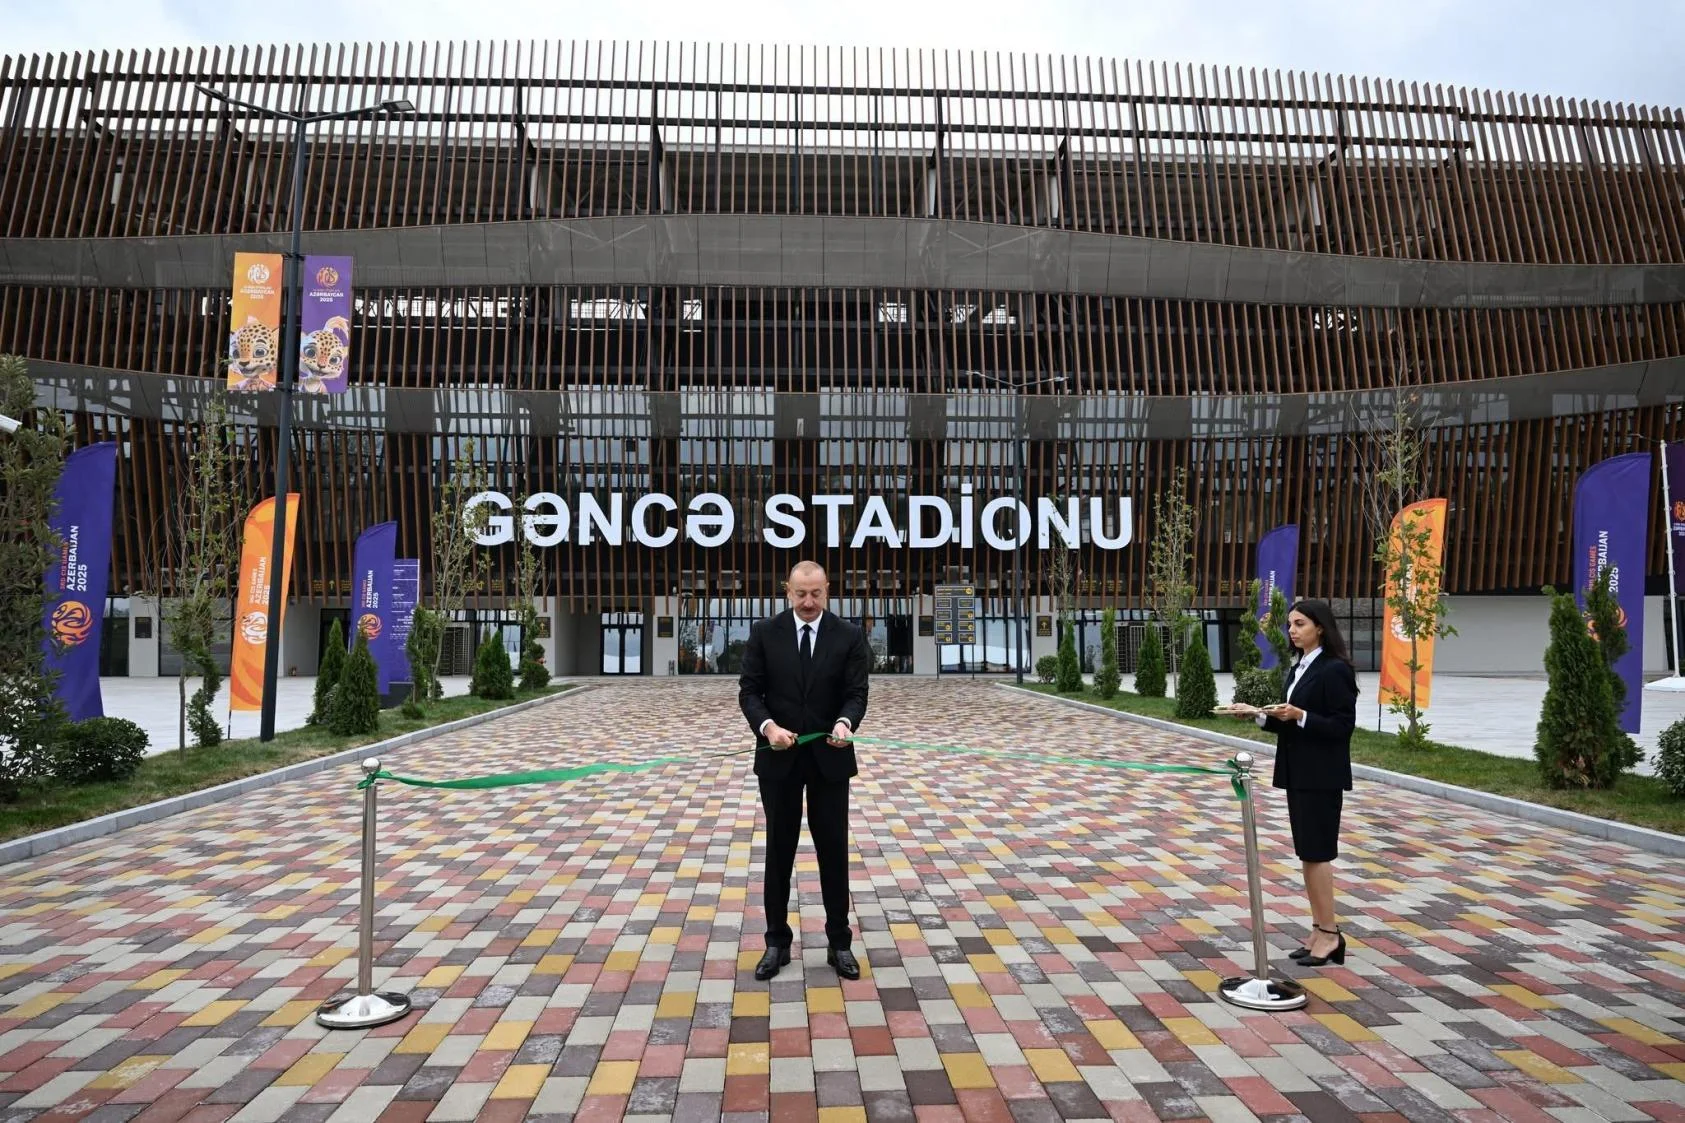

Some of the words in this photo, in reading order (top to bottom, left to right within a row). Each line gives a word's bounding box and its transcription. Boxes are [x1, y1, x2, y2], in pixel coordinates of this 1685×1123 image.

[463, 491, 734, 547] GƏNCƏ
[763, 483, 1133, 550] STADİONU
[66, 525, 79, 591] AZERBAIJAN
[77, 564, 87, 592] 2025
[1589, 545, 1597, 567] GAMES
[1597, 530, 1608, 582] RBAIJAN
[254, 556, 267, 605] AZERBAIJAN
[366, 570, 374, 609] AZERBAIJAN
[1608, 567, 1619, 593] 2025
